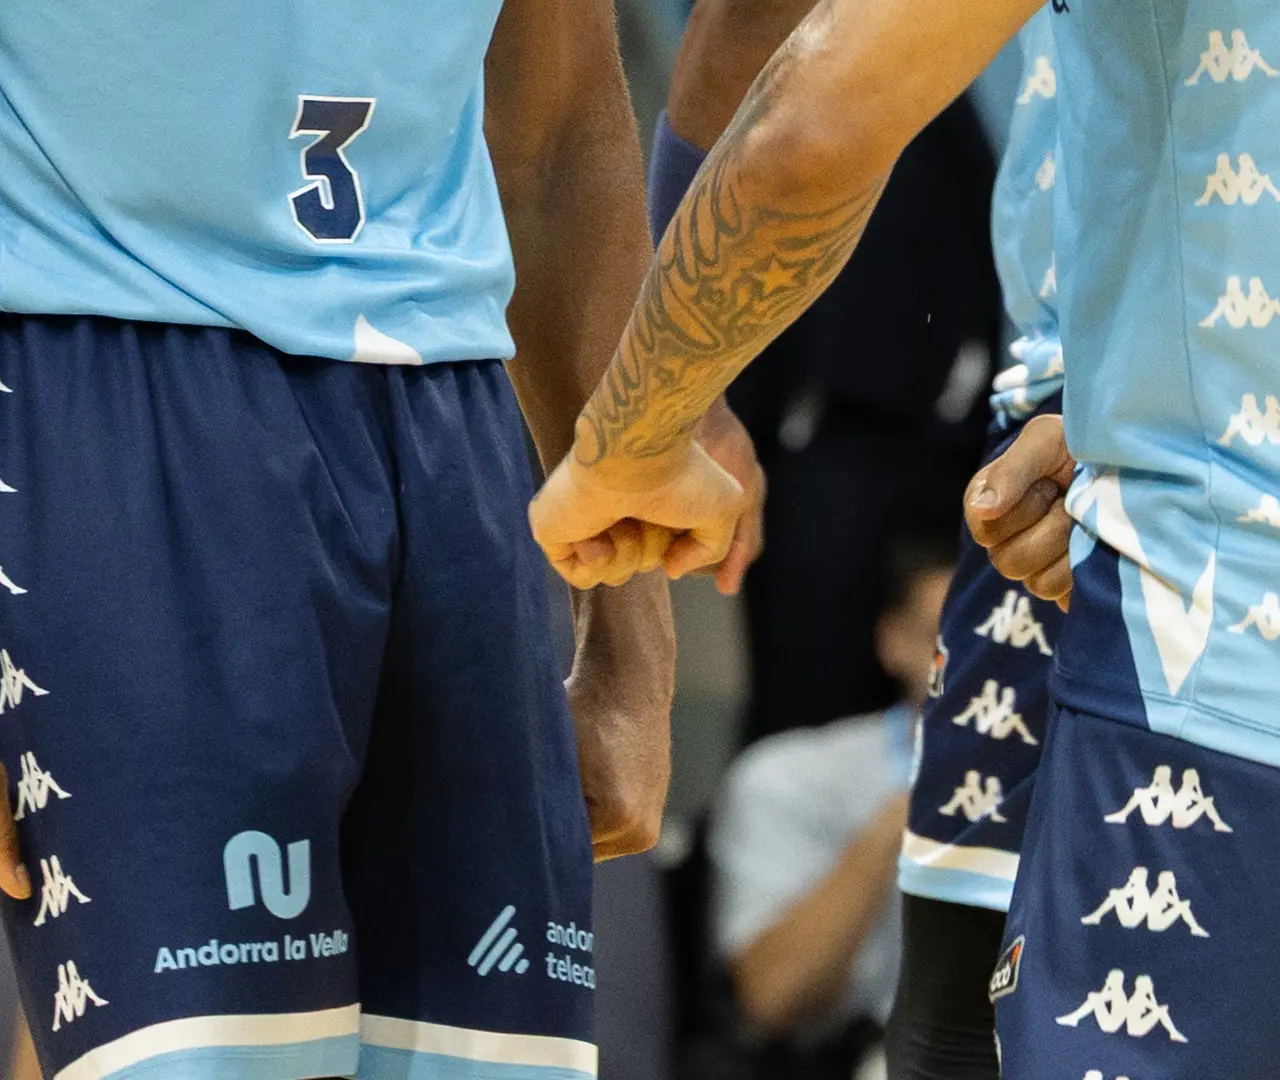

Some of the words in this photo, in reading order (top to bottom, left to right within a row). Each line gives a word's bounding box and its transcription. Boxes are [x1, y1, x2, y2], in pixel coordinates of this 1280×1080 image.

[287, 93, 377, 245] 3
[153, 938, 280, 974] Andorra
[283, 934, 307, 961] la
